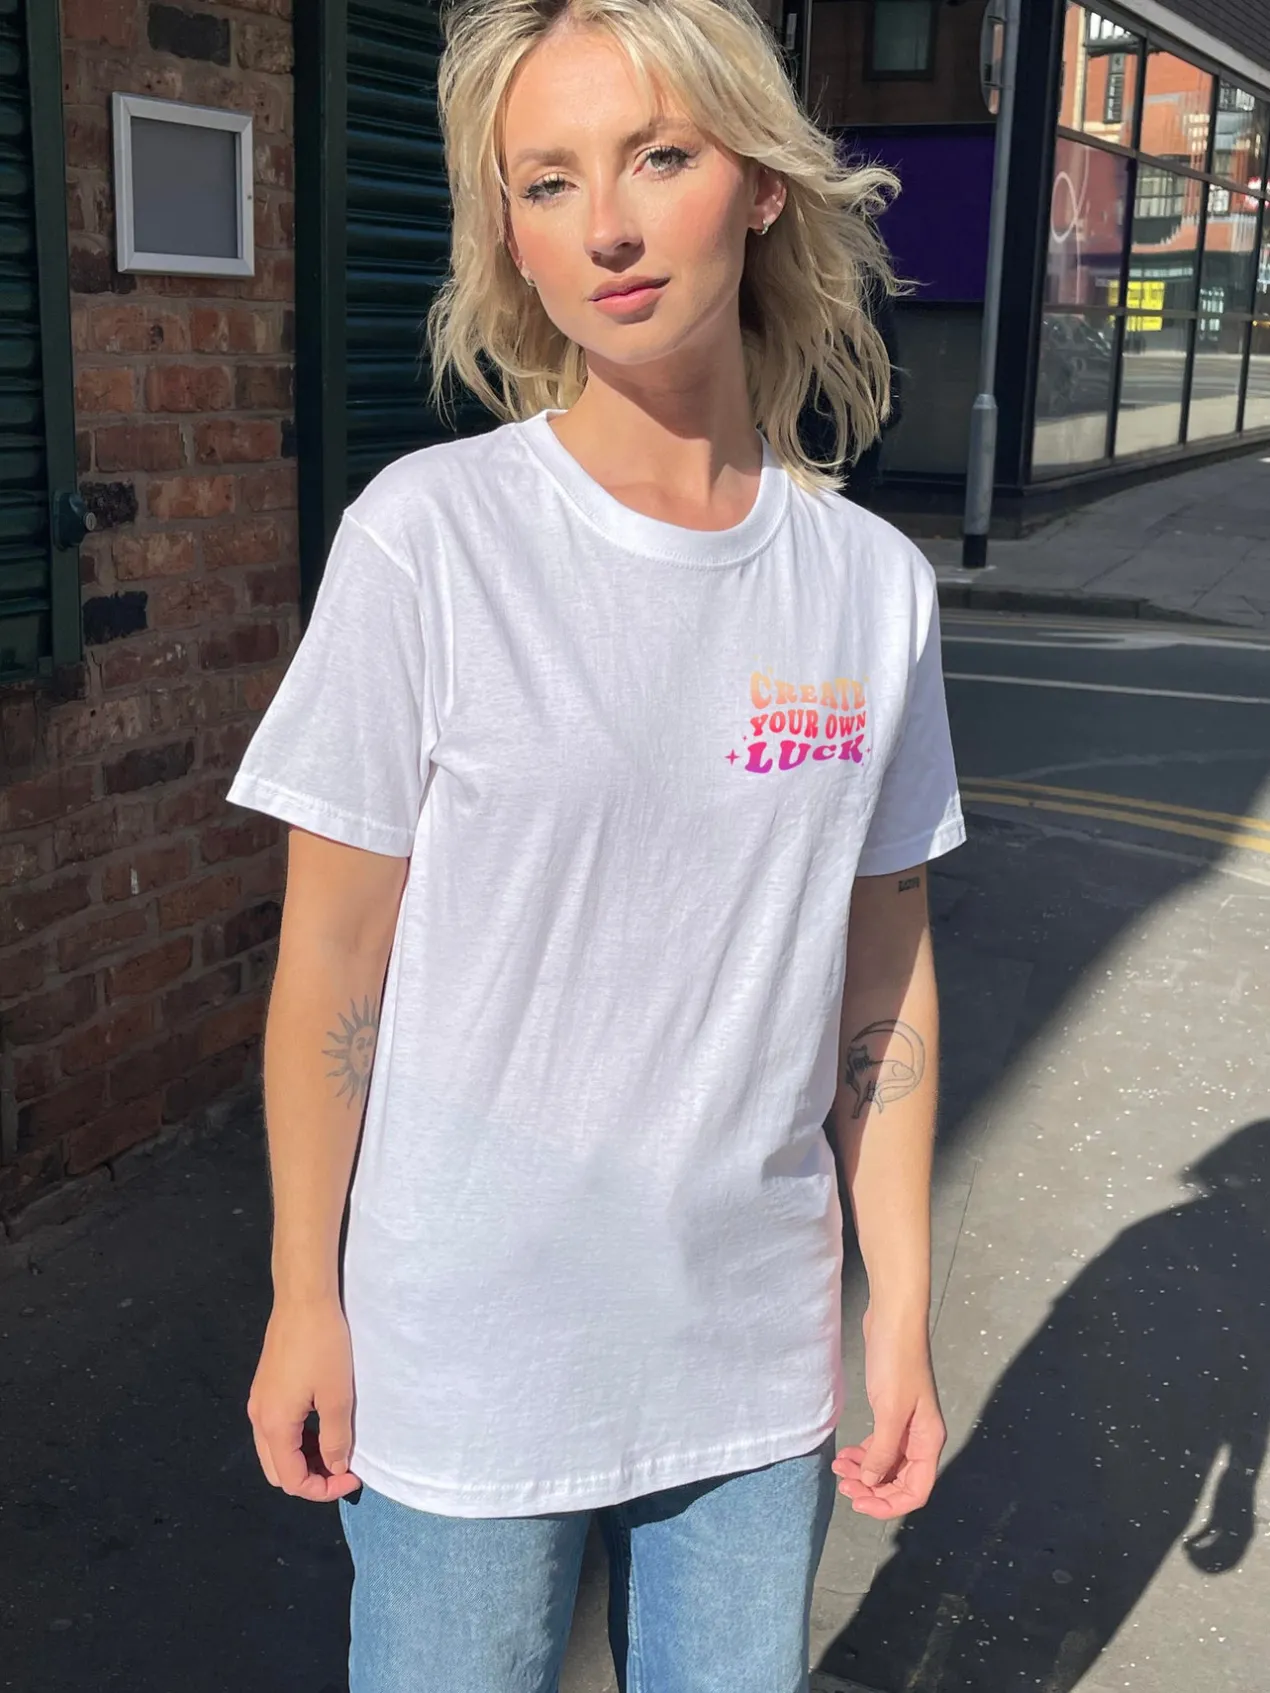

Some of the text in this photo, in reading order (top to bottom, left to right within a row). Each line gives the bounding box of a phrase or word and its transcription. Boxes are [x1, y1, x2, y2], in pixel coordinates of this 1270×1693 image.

[751, 671, 866, 712] CREATE
[750, 709, 866, 740] YOUR OWN
[745, 734, 865, 774] LUCK
